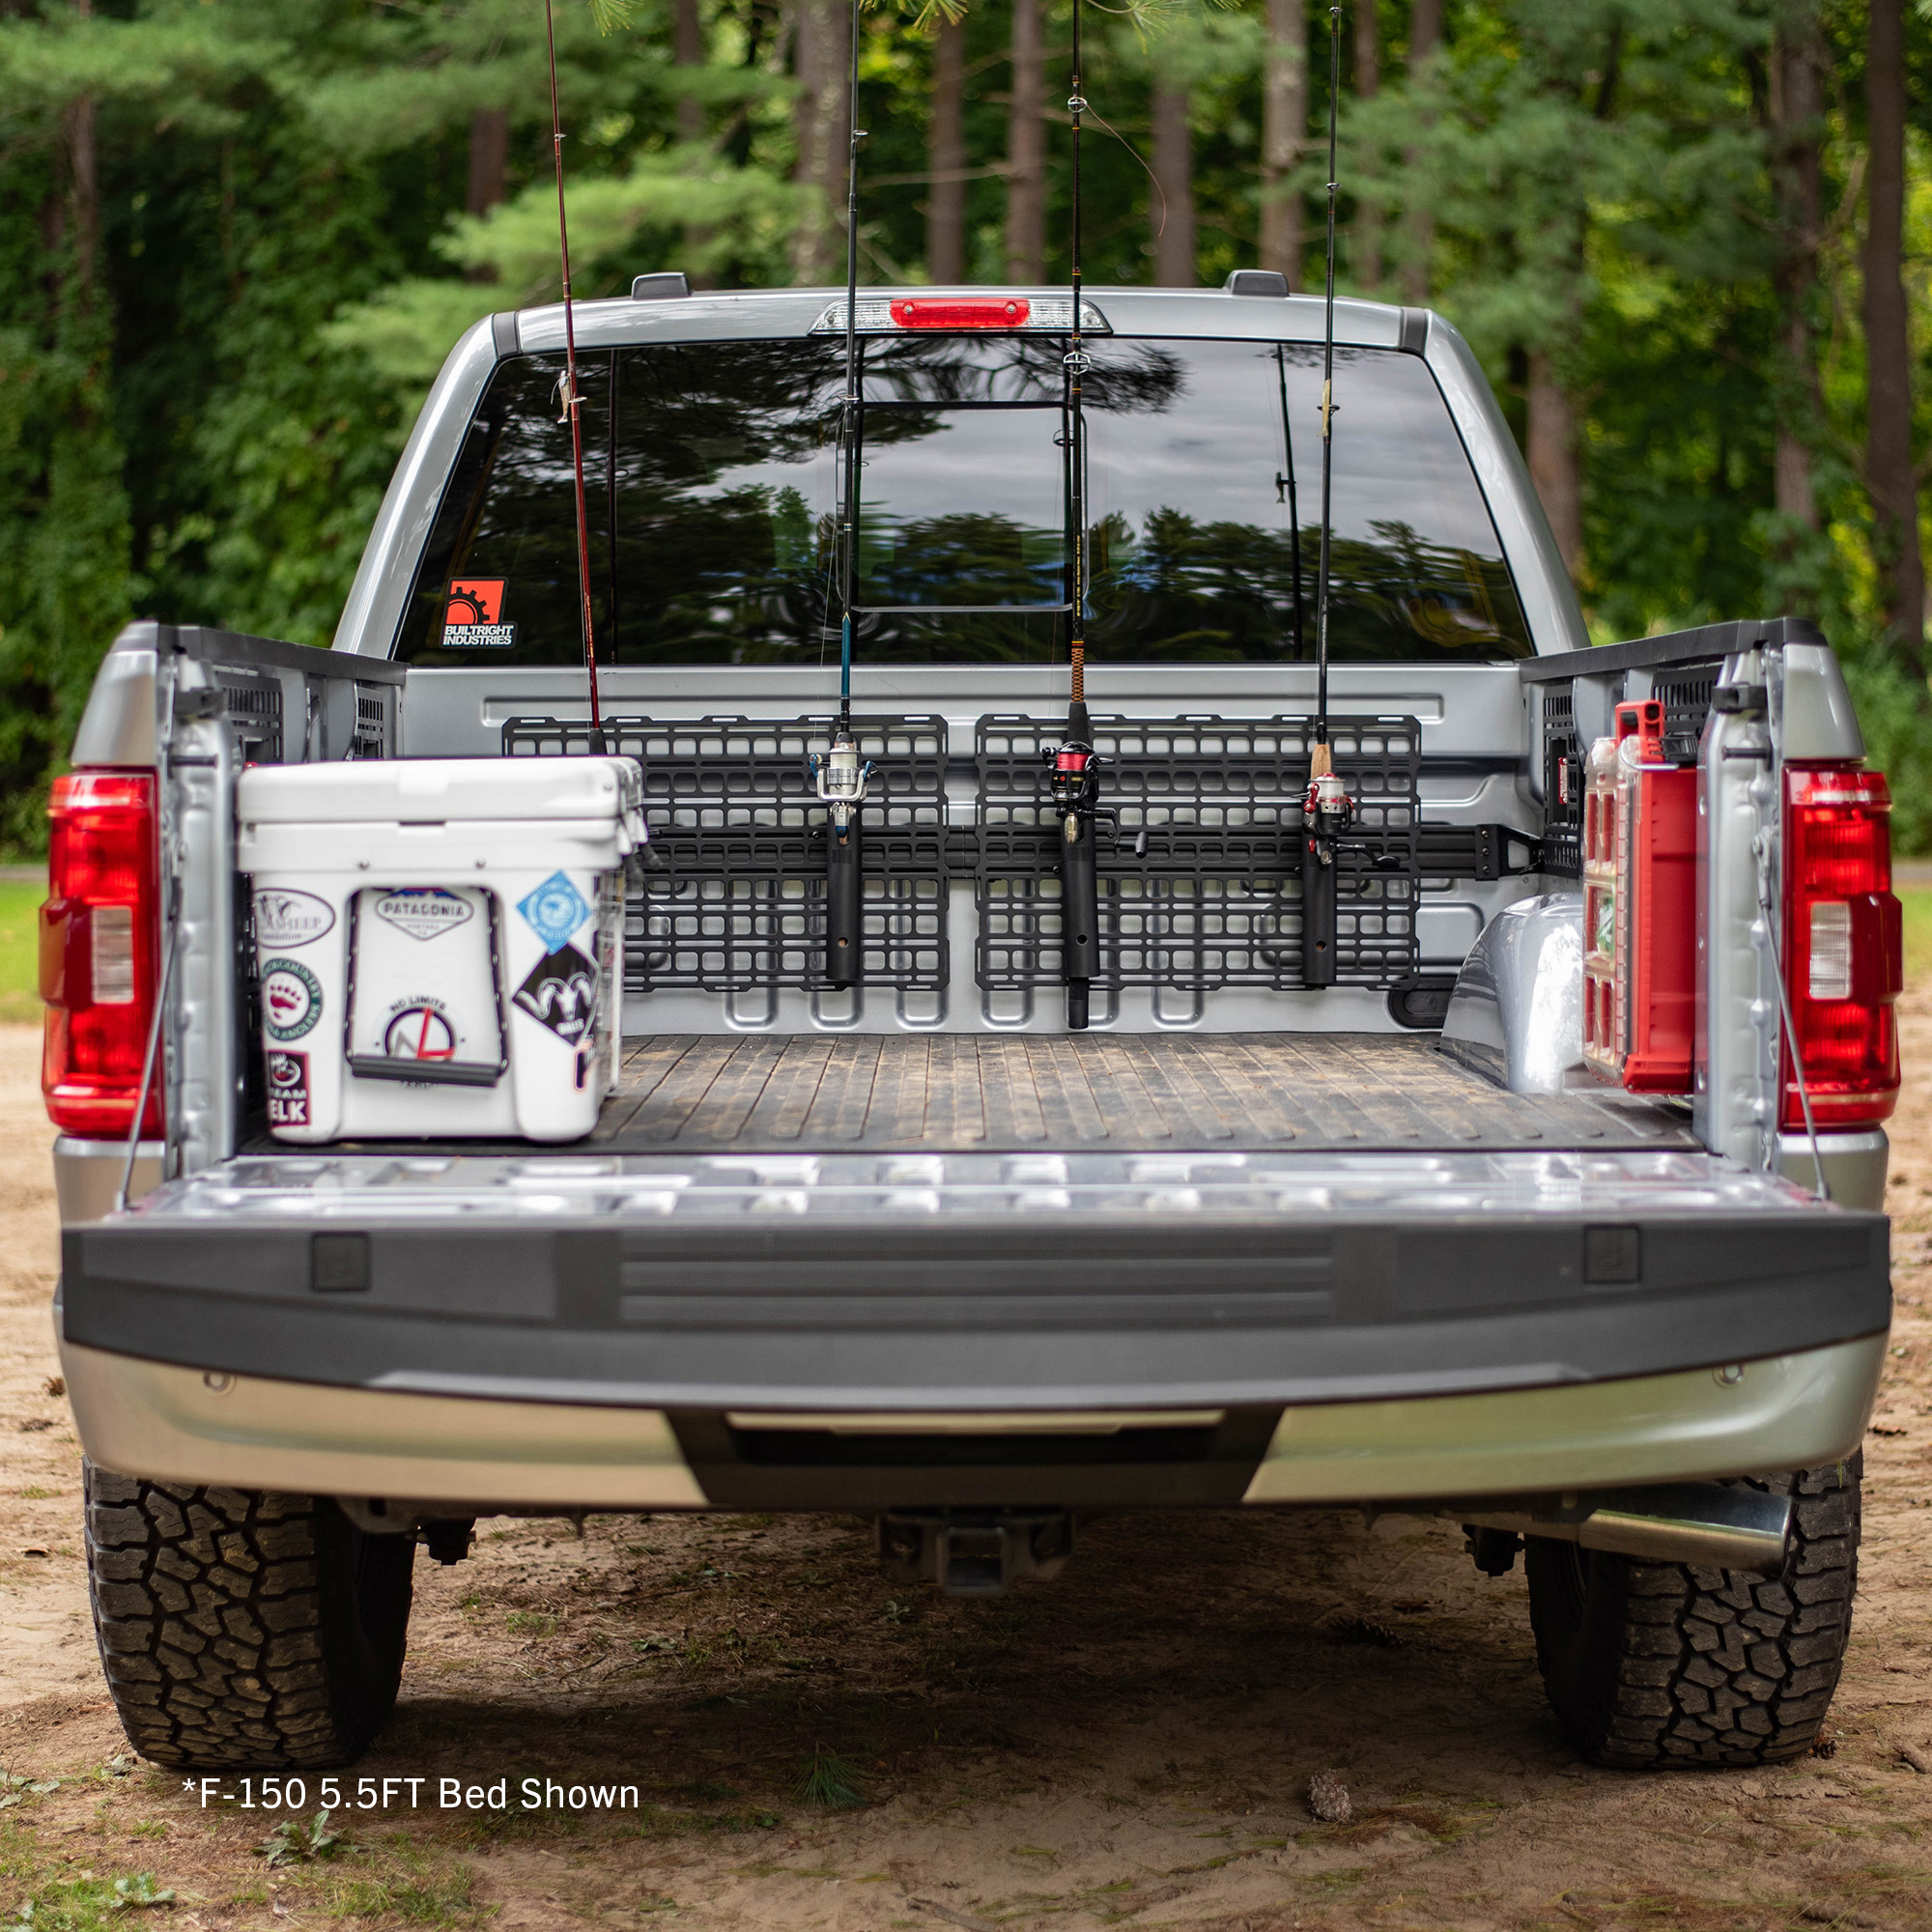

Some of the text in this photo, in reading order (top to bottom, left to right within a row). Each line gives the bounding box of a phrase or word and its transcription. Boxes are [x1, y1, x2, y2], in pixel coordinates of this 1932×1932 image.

[444, 625, 514, 636] BUILTRIGHT
[442, 635, 512, 645] INDUSTRIES
[384, 901, 464, 917] PATAGONIA
[389, 994, 447, 1012] NO LIMITS
[270, 1099, 307, 1122] ELK
